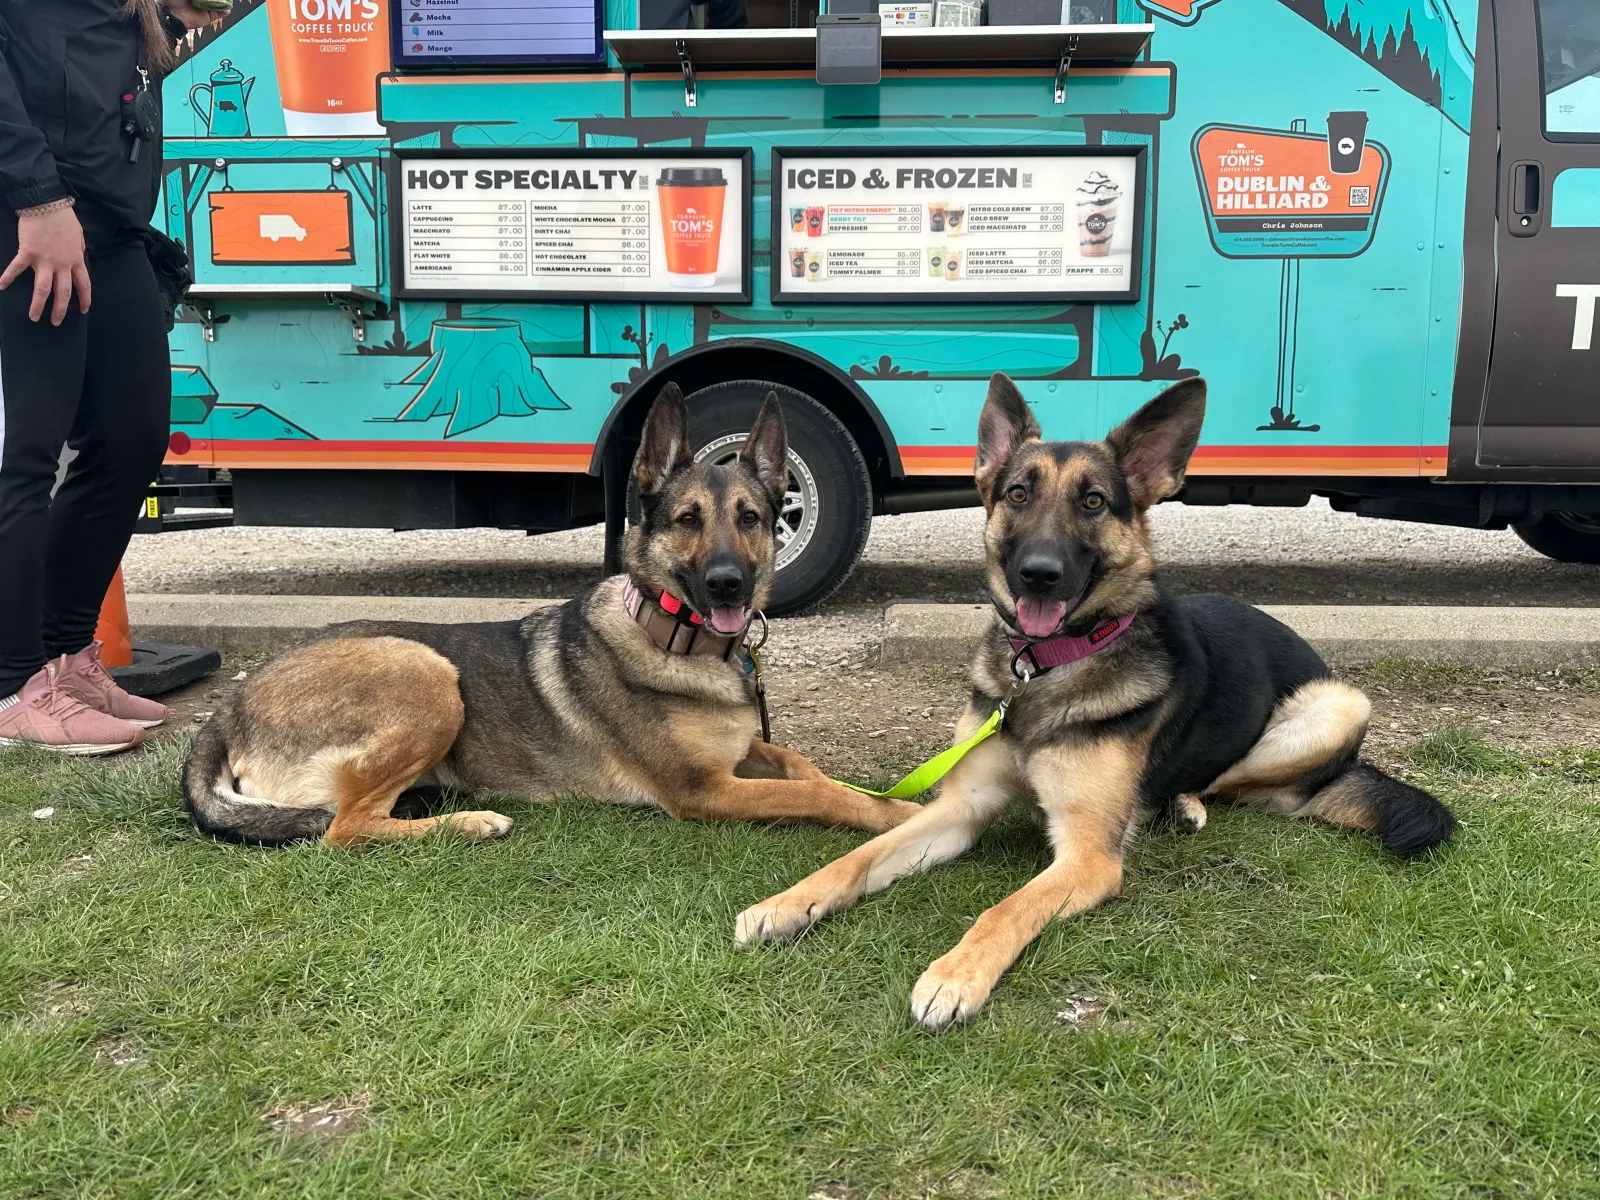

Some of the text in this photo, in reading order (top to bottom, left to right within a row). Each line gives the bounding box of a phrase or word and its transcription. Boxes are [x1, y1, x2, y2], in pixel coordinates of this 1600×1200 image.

[289, 0, 379, 20] TOM'S
[292, 22, 373, 33] COFFEE TRUCK
[1218, 155, 1264, 166] TOM'S
[408, 170, 637, 190] HOT SPECIALTY
[788, 168, 1017, 189] ICED & FROZEN
[1217, 175, 1331, 192] DUBLIN &
[1217, 193, 1328, 209] HILLIARD
[670, 220, 714, 232] TOM'S
